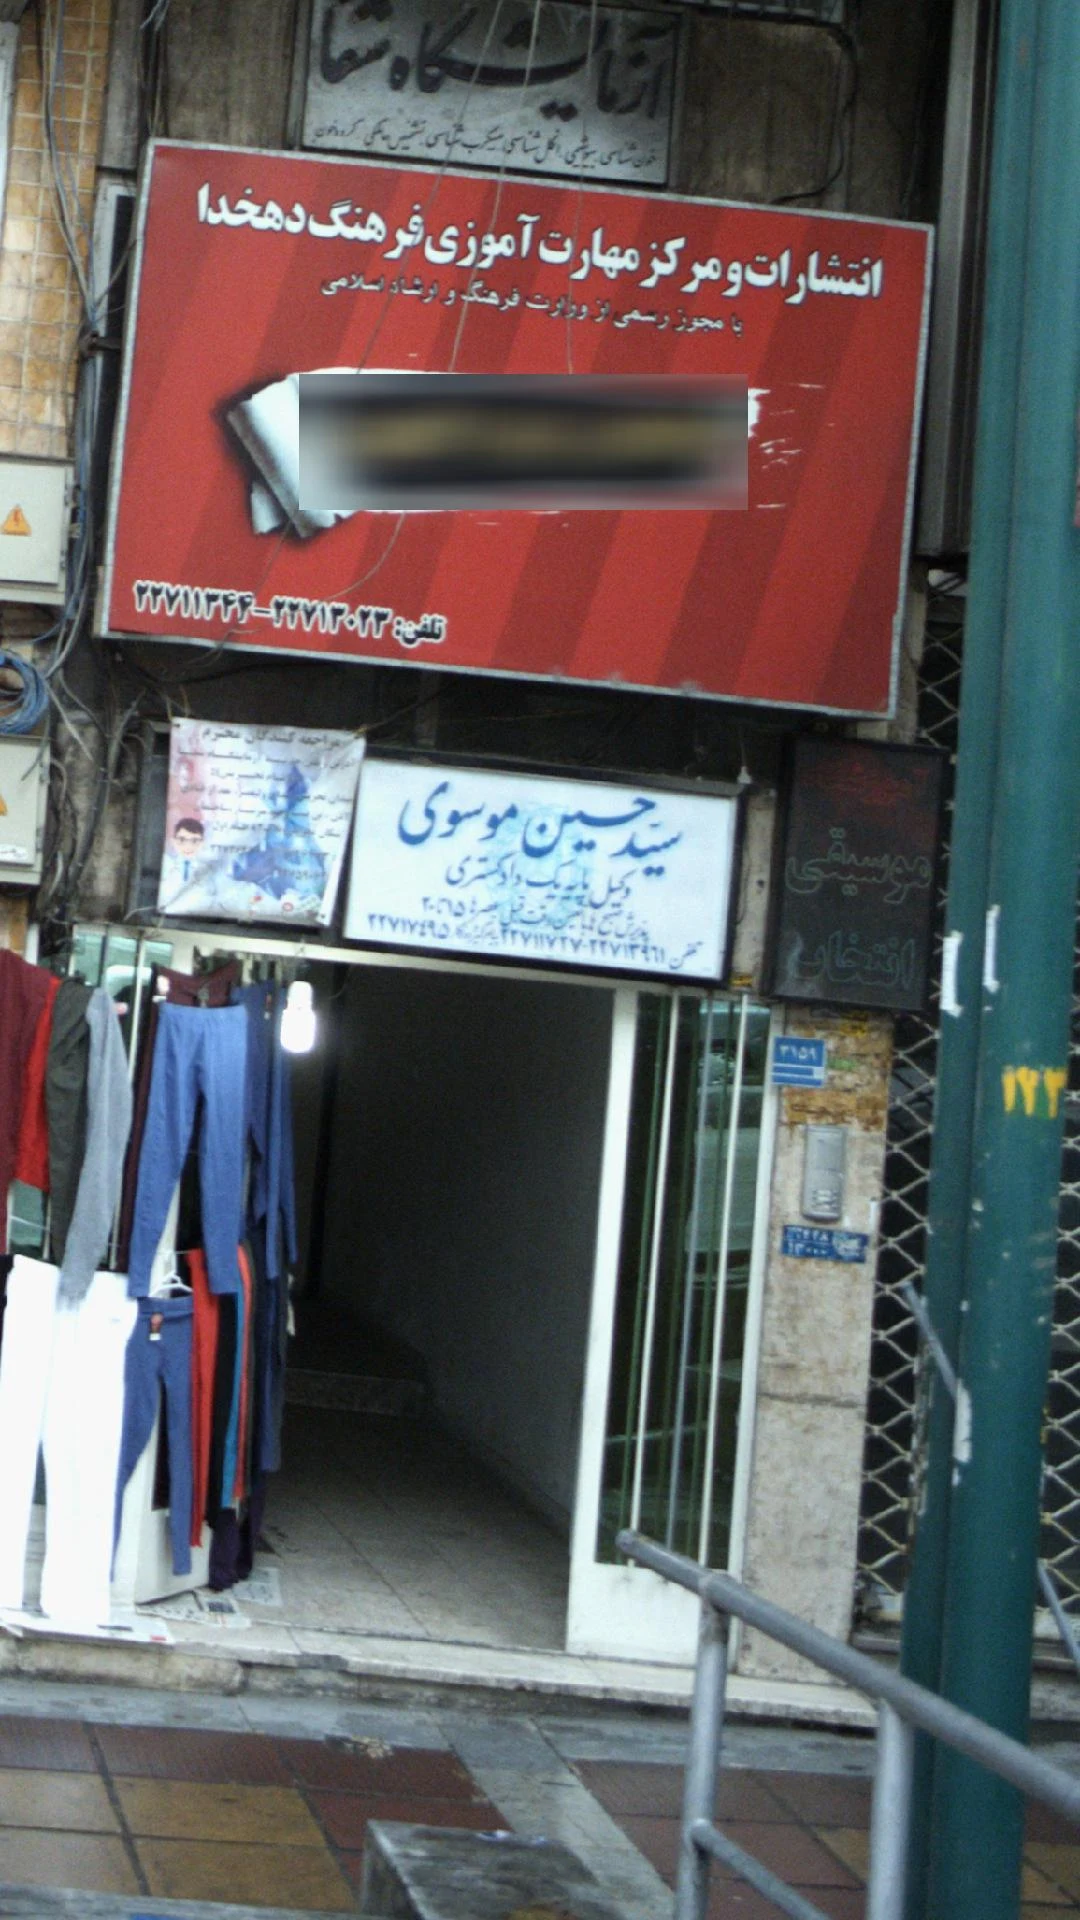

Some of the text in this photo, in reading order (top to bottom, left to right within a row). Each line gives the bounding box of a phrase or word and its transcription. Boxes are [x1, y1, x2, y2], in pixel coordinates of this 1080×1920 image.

[197, 182, 884, 305] انتشارات و مرکز مهارت آموزی فرهنگ دهخدا
[320, 272, 386, 297] اسلامی
[389, 275, 439, 304] ارشاد
[443, 288, 457, 306] و
[460, 279, 521, 312] فرهنگ
[594, 299, 611, 323] از
[613, 309, 670, 331] رسمی
[675, 308, 725, 333] مجوز
[731, 311, 744, 338] با
[398, 780, 519, 846] موسوی
[521, 796, 657, 858] حسین
[784, 827, 933, 904] موسیقی
